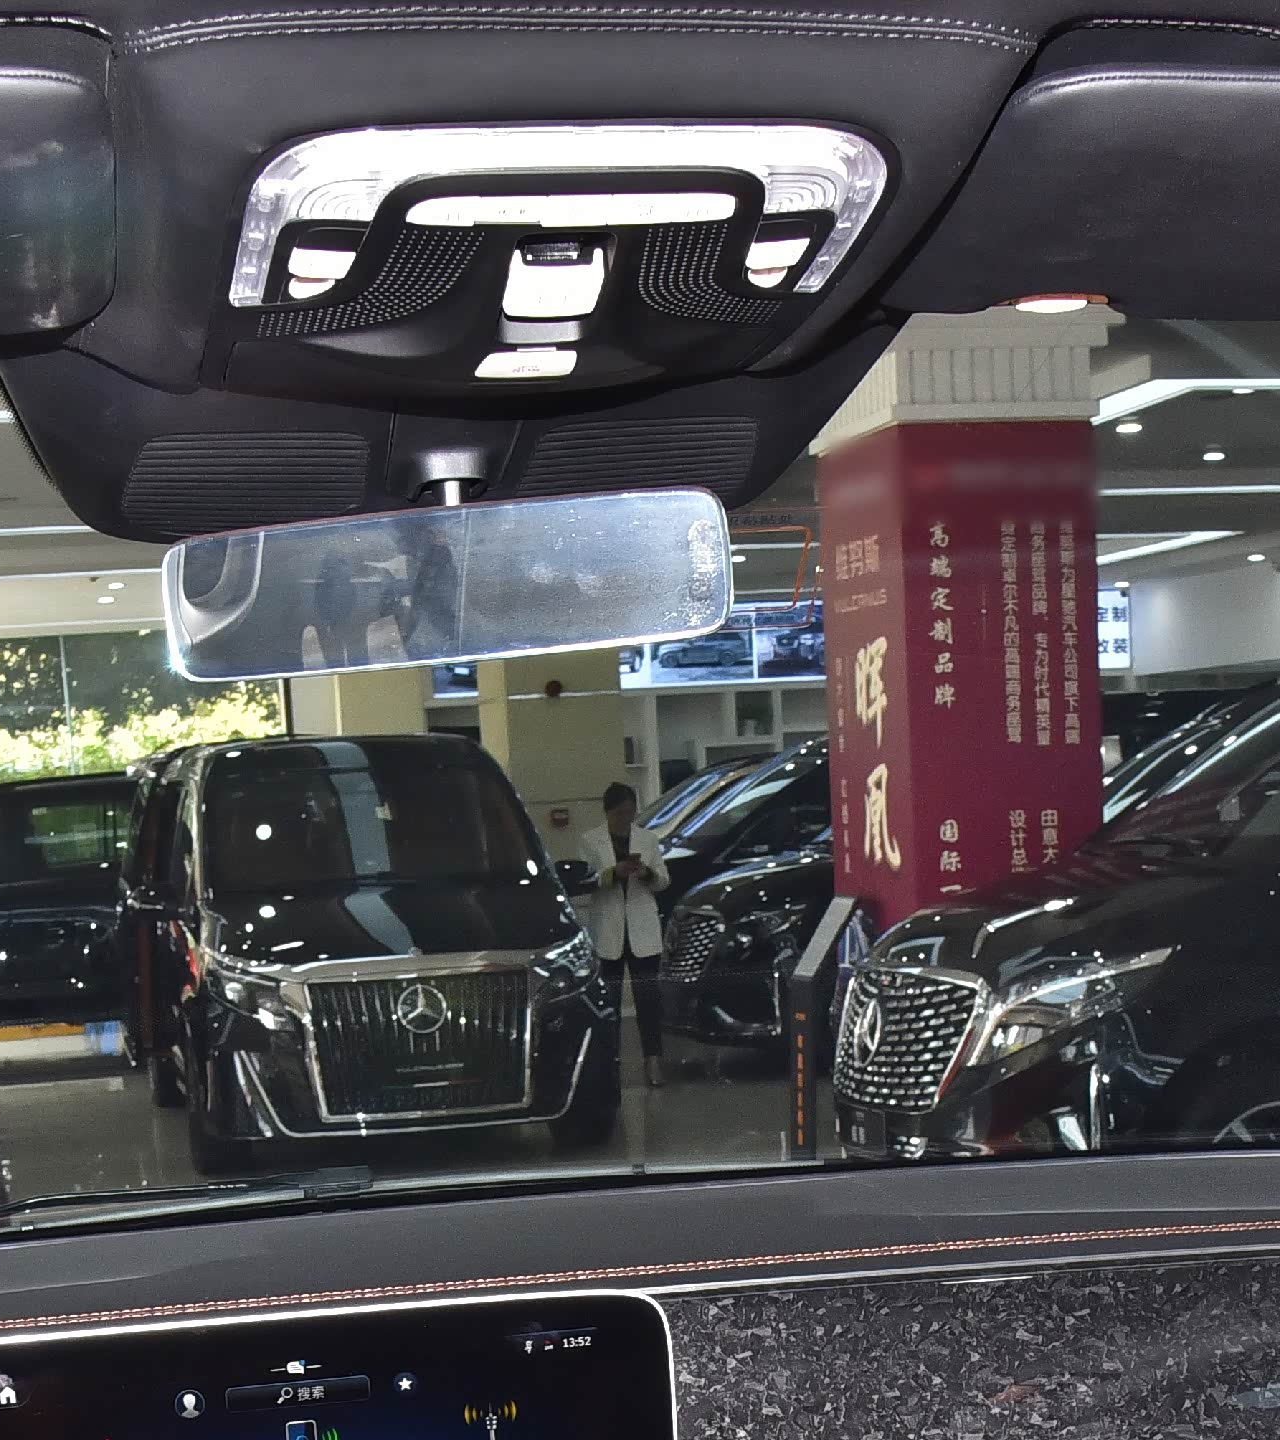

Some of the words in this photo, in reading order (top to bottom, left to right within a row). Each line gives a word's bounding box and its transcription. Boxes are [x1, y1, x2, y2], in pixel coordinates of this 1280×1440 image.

[928, 521, 956, 709] 高端定制品牌
[562, 1336, 592, 1348] 13:52
[297, 1385, 325, 1401] 搜索
